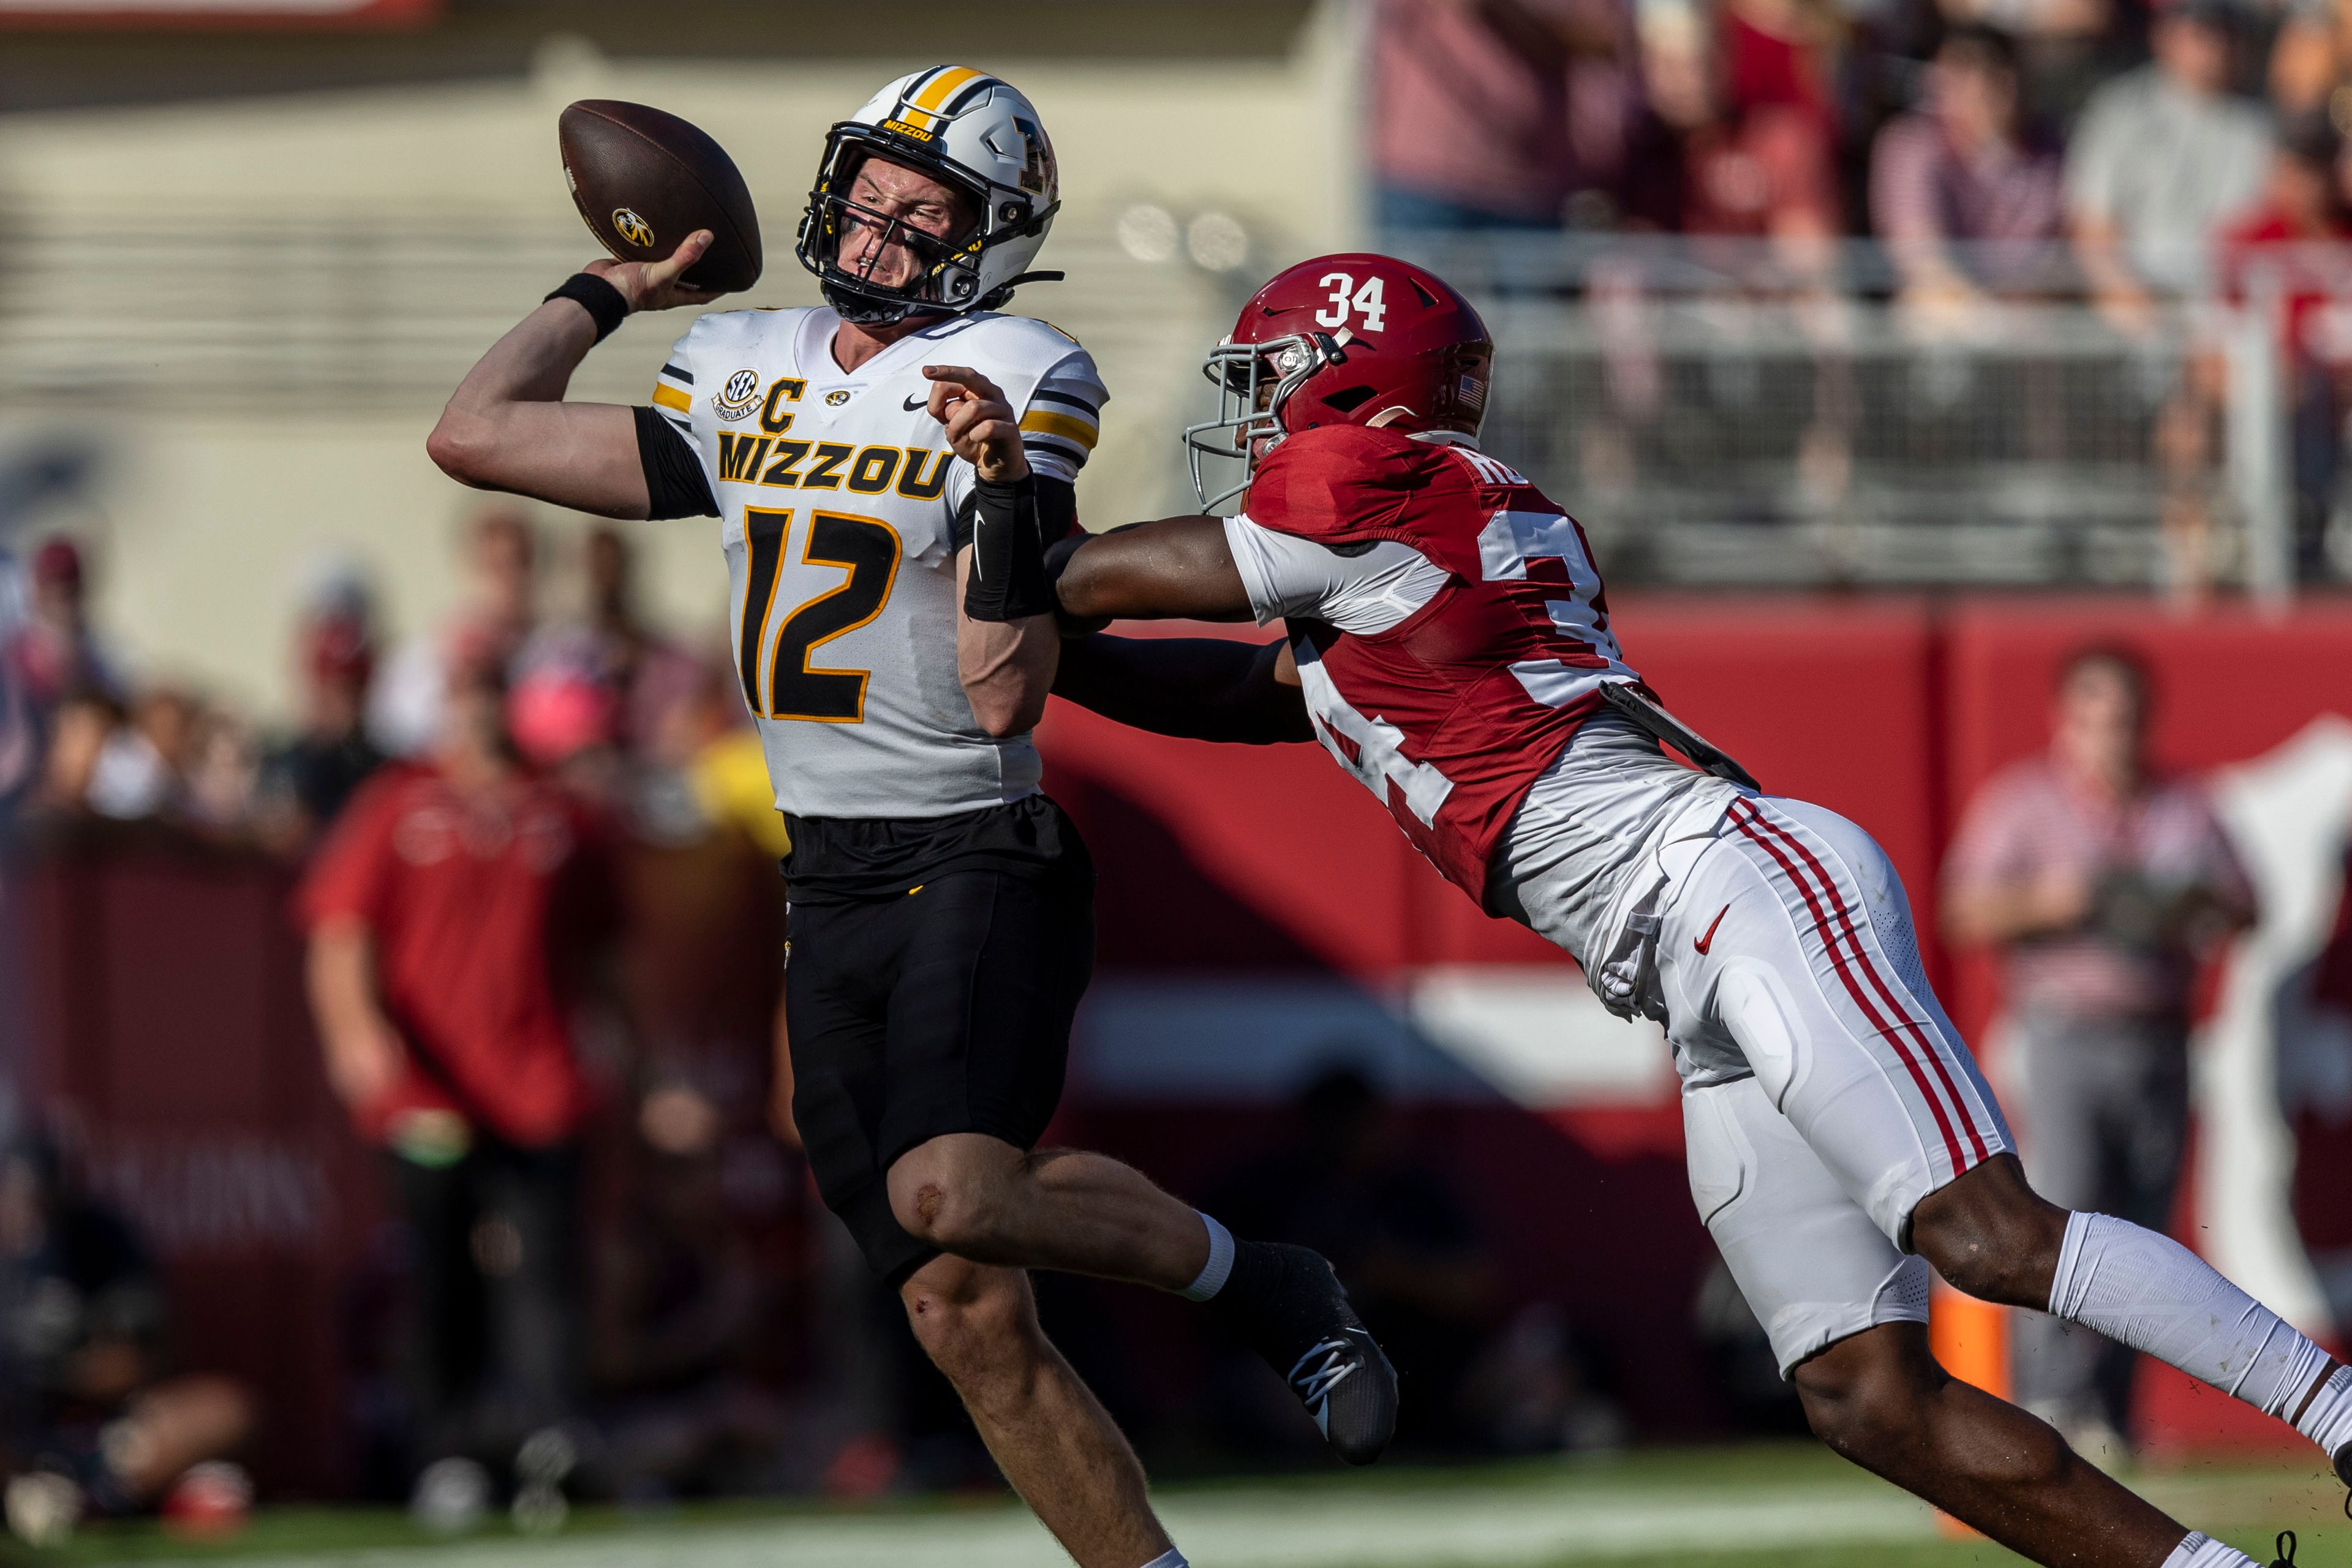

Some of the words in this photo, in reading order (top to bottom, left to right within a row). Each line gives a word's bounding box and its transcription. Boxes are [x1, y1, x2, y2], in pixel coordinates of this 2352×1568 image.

[883, 119, 933, 142] MIZZOU
[1315, 273, 1386, 332] 34
[715, 404, 753, 420] GRADUATE
[726, 371, 756, 402] SEC
[758, 377, 807, 437] C
[717, 430, 956, 501] MIZZOU
[740, 505, 902, 724] 12
[1477, 510, 1640, 709] 3
[1293, 635, 1454, 831] 4
